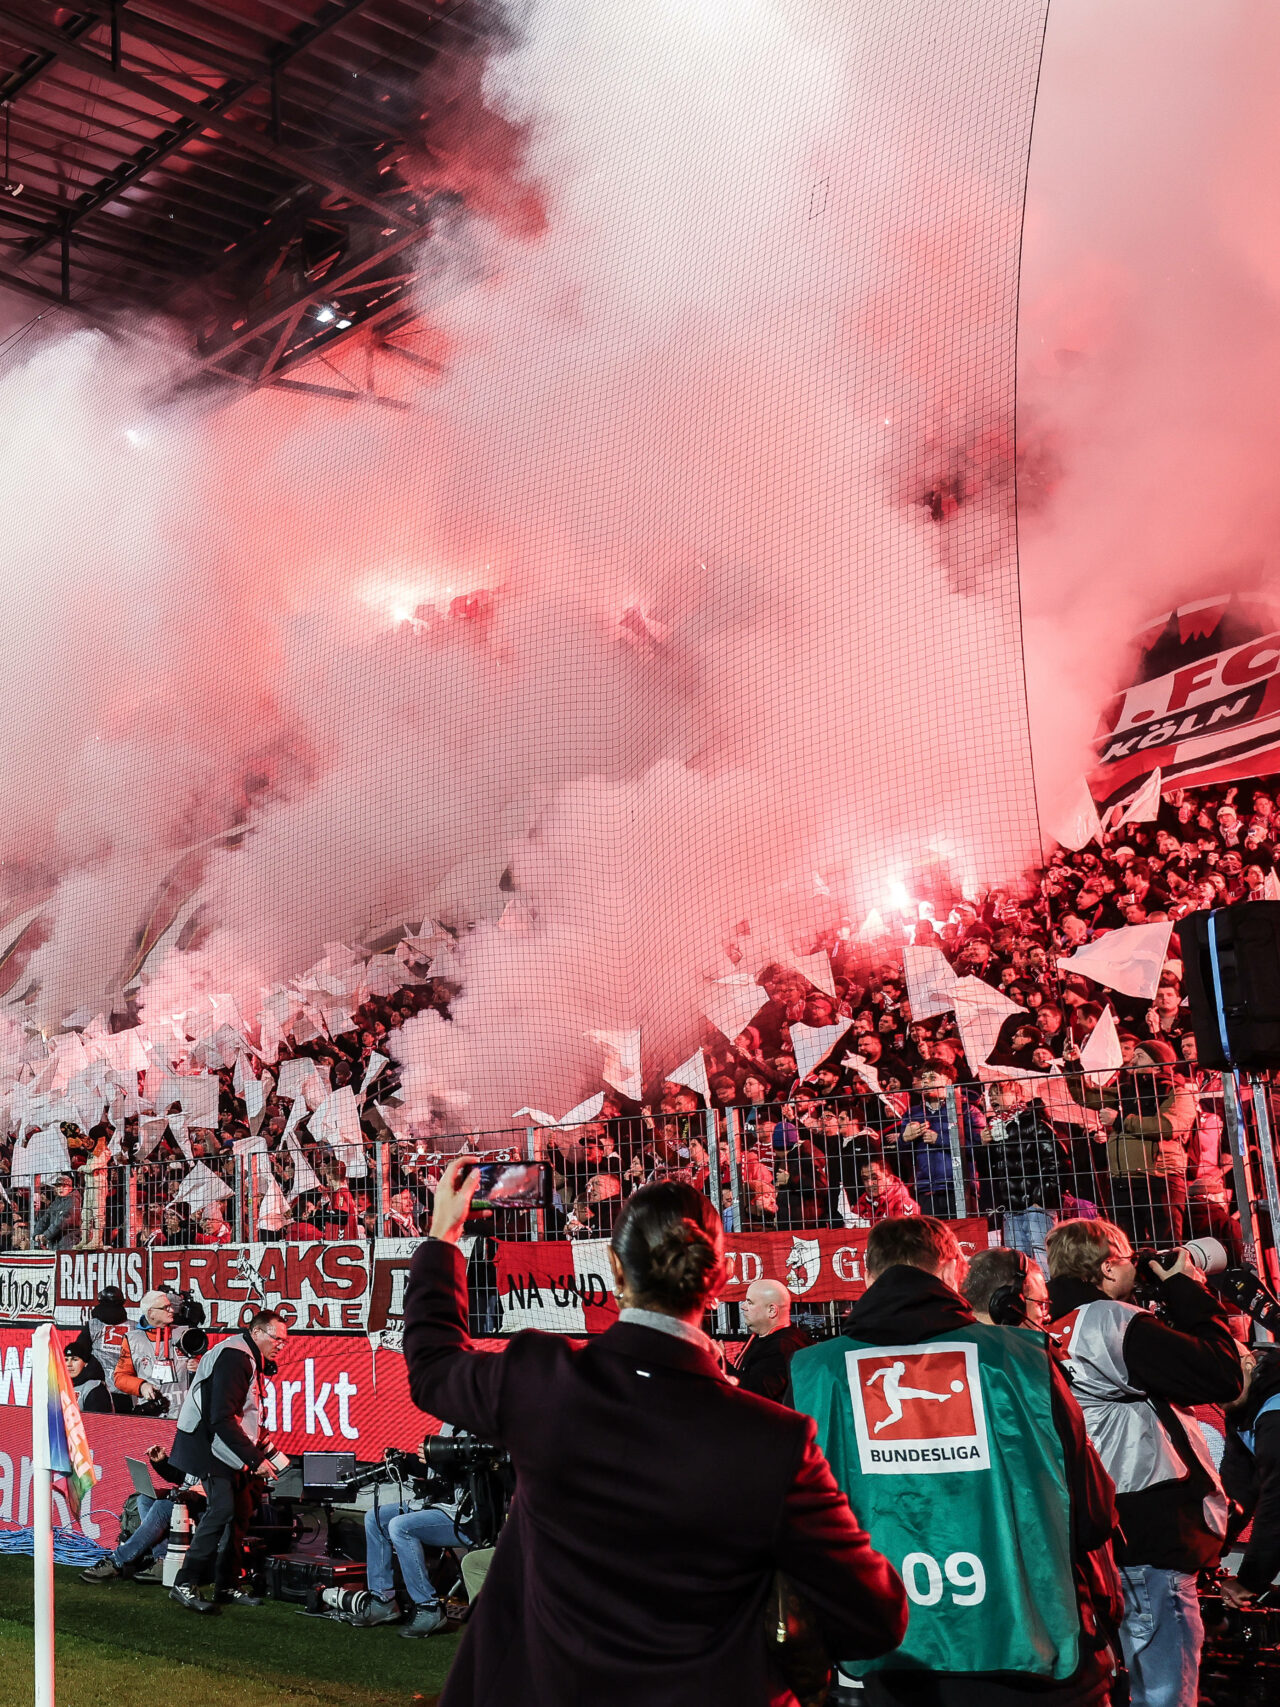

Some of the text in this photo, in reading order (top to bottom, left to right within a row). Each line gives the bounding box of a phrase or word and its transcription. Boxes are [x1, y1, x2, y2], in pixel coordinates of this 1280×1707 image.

[1098, 694, 1251, 765] KÖLN
[60, 1252, 145, 1303] RAFIKIS
[153, 1245, 367, 1301] FREAKS
[507, 1272, 608, 1310] NA UND
[209, 1302, 363, 1328] LOGNE
[265, 1358, 359, 1440] arkt
[871, 1445, 981, 1463] BUNDESLIGA
[901, 1551, 986, 1607] 09
